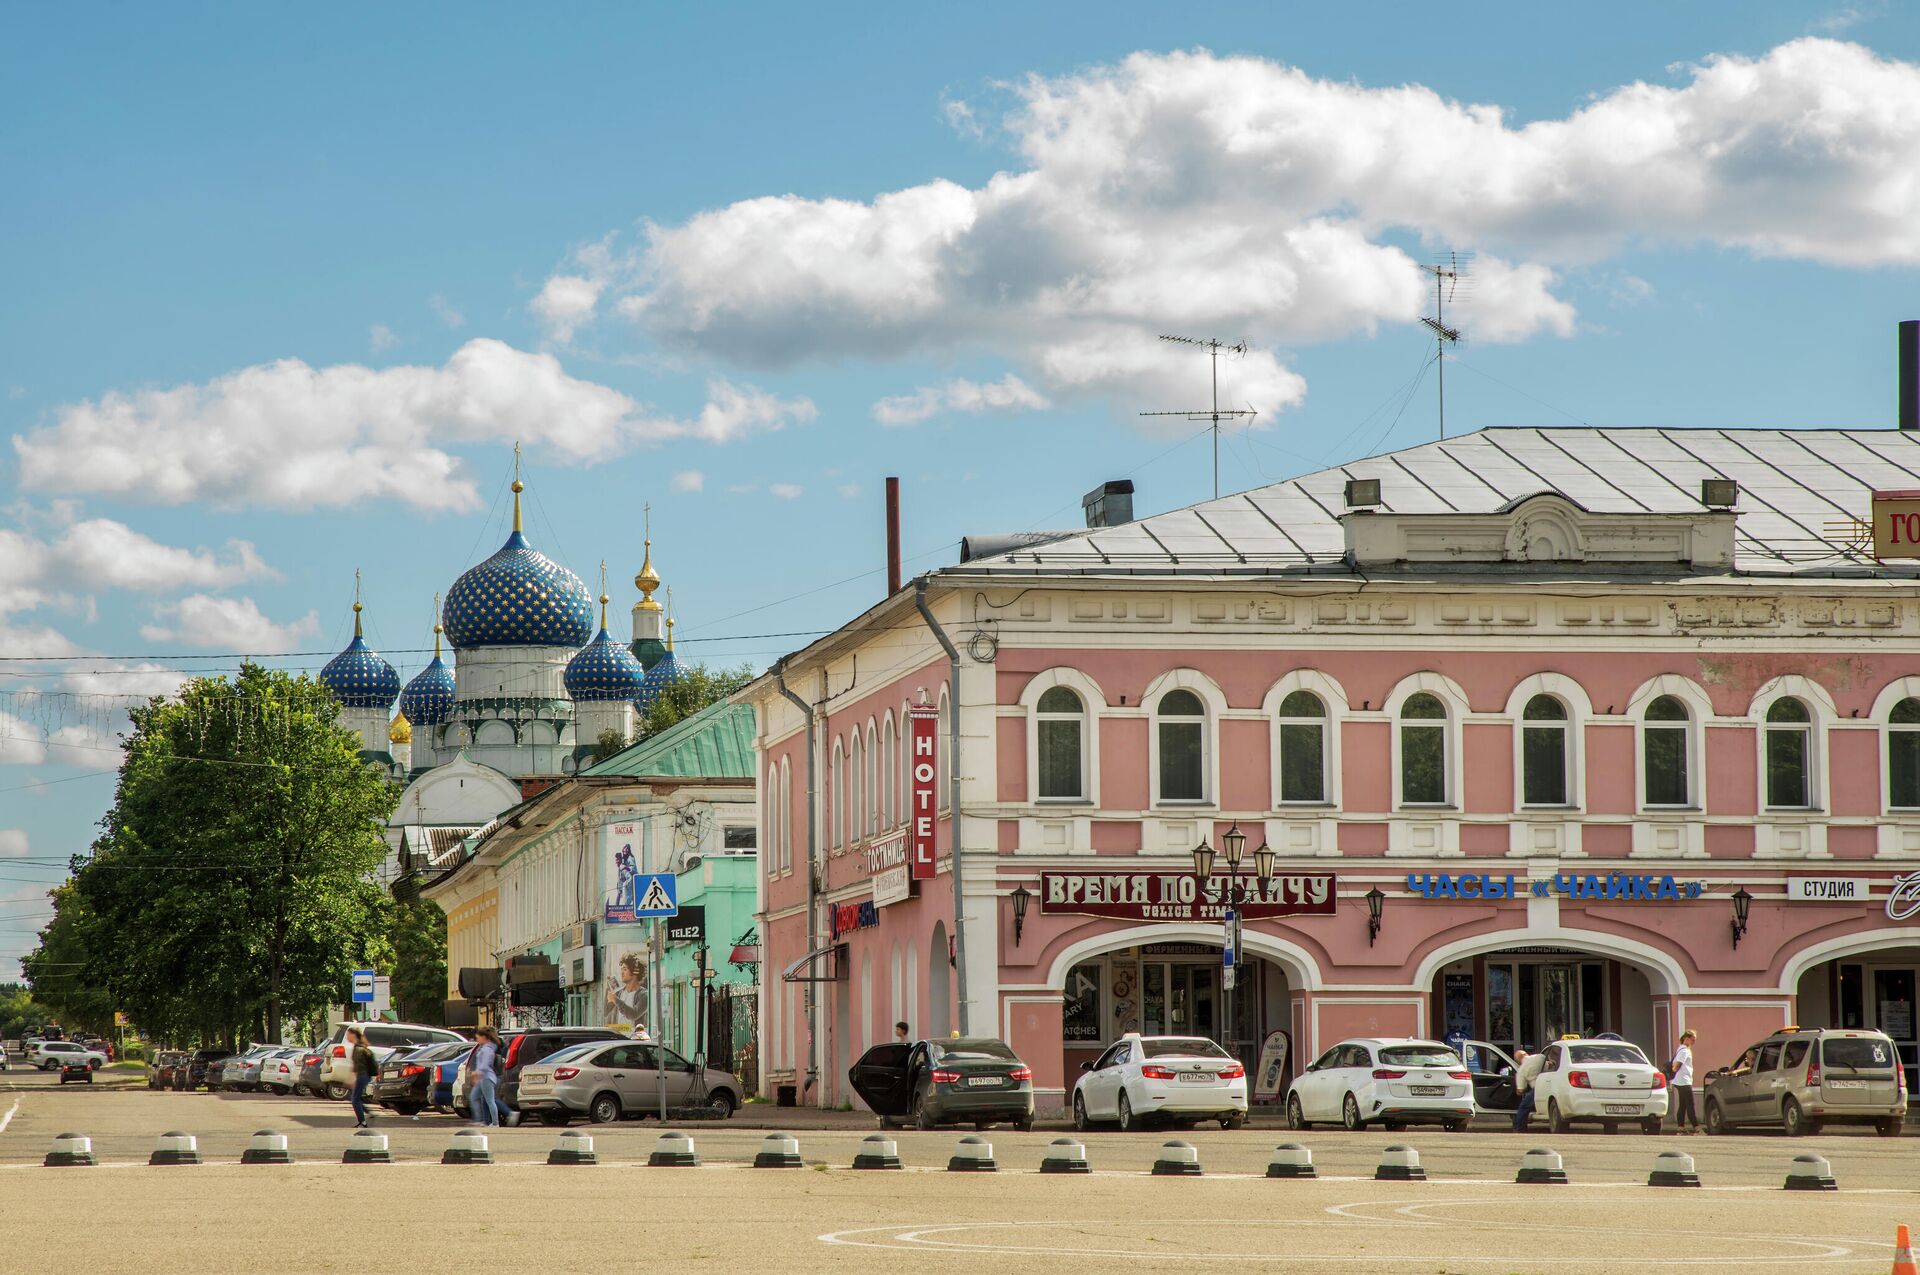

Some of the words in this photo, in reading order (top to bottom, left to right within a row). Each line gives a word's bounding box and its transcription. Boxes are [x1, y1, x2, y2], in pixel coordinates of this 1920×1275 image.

[914, 735, 935, 863] HOTEL
[867, 837, 906, 873] ГОСТИНИЦА
[1045, 875, 1151, 904] ВРЕМЯ
[1157, 875, 1197, 904] ПО
[1406, 873, 1516, 899] ЧАСЫ
[1530, 870, 1703, 899] «ЧАЙКА»
[1803, 881, 1855, 898] СТУДИЯ
[1142, 905, 1192, 918] UGLICH
[1200, 905, 1232, 918] TIM
[671, 926, 699, 938] TELE2
